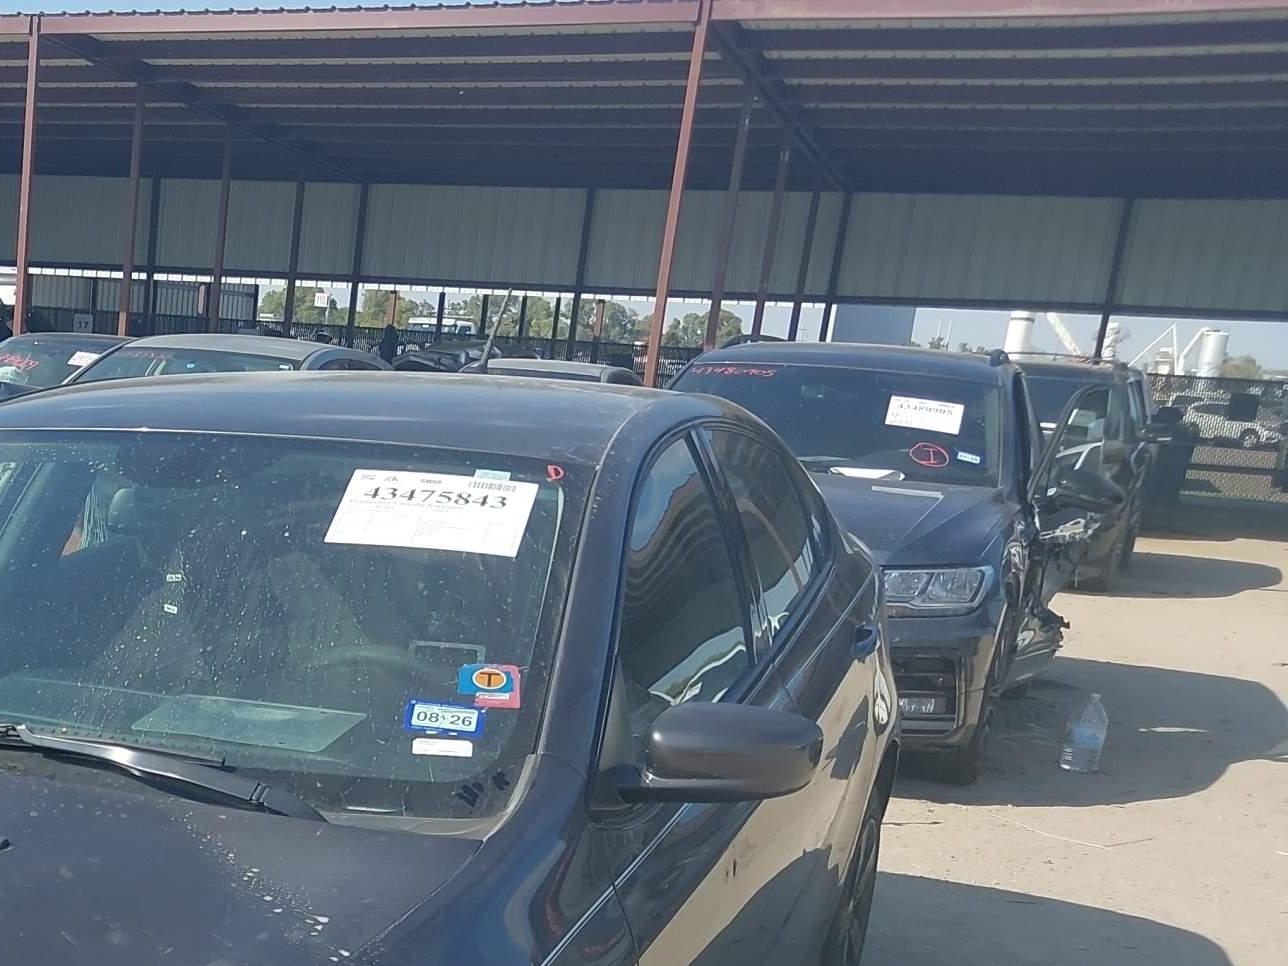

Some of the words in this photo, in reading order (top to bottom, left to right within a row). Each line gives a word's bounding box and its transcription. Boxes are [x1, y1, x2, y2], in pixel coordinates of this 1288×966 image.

[363, 486, 508, 509] 43475843
[416, 710, 440, 723] 08
[449, 714, 473, 727] 26
